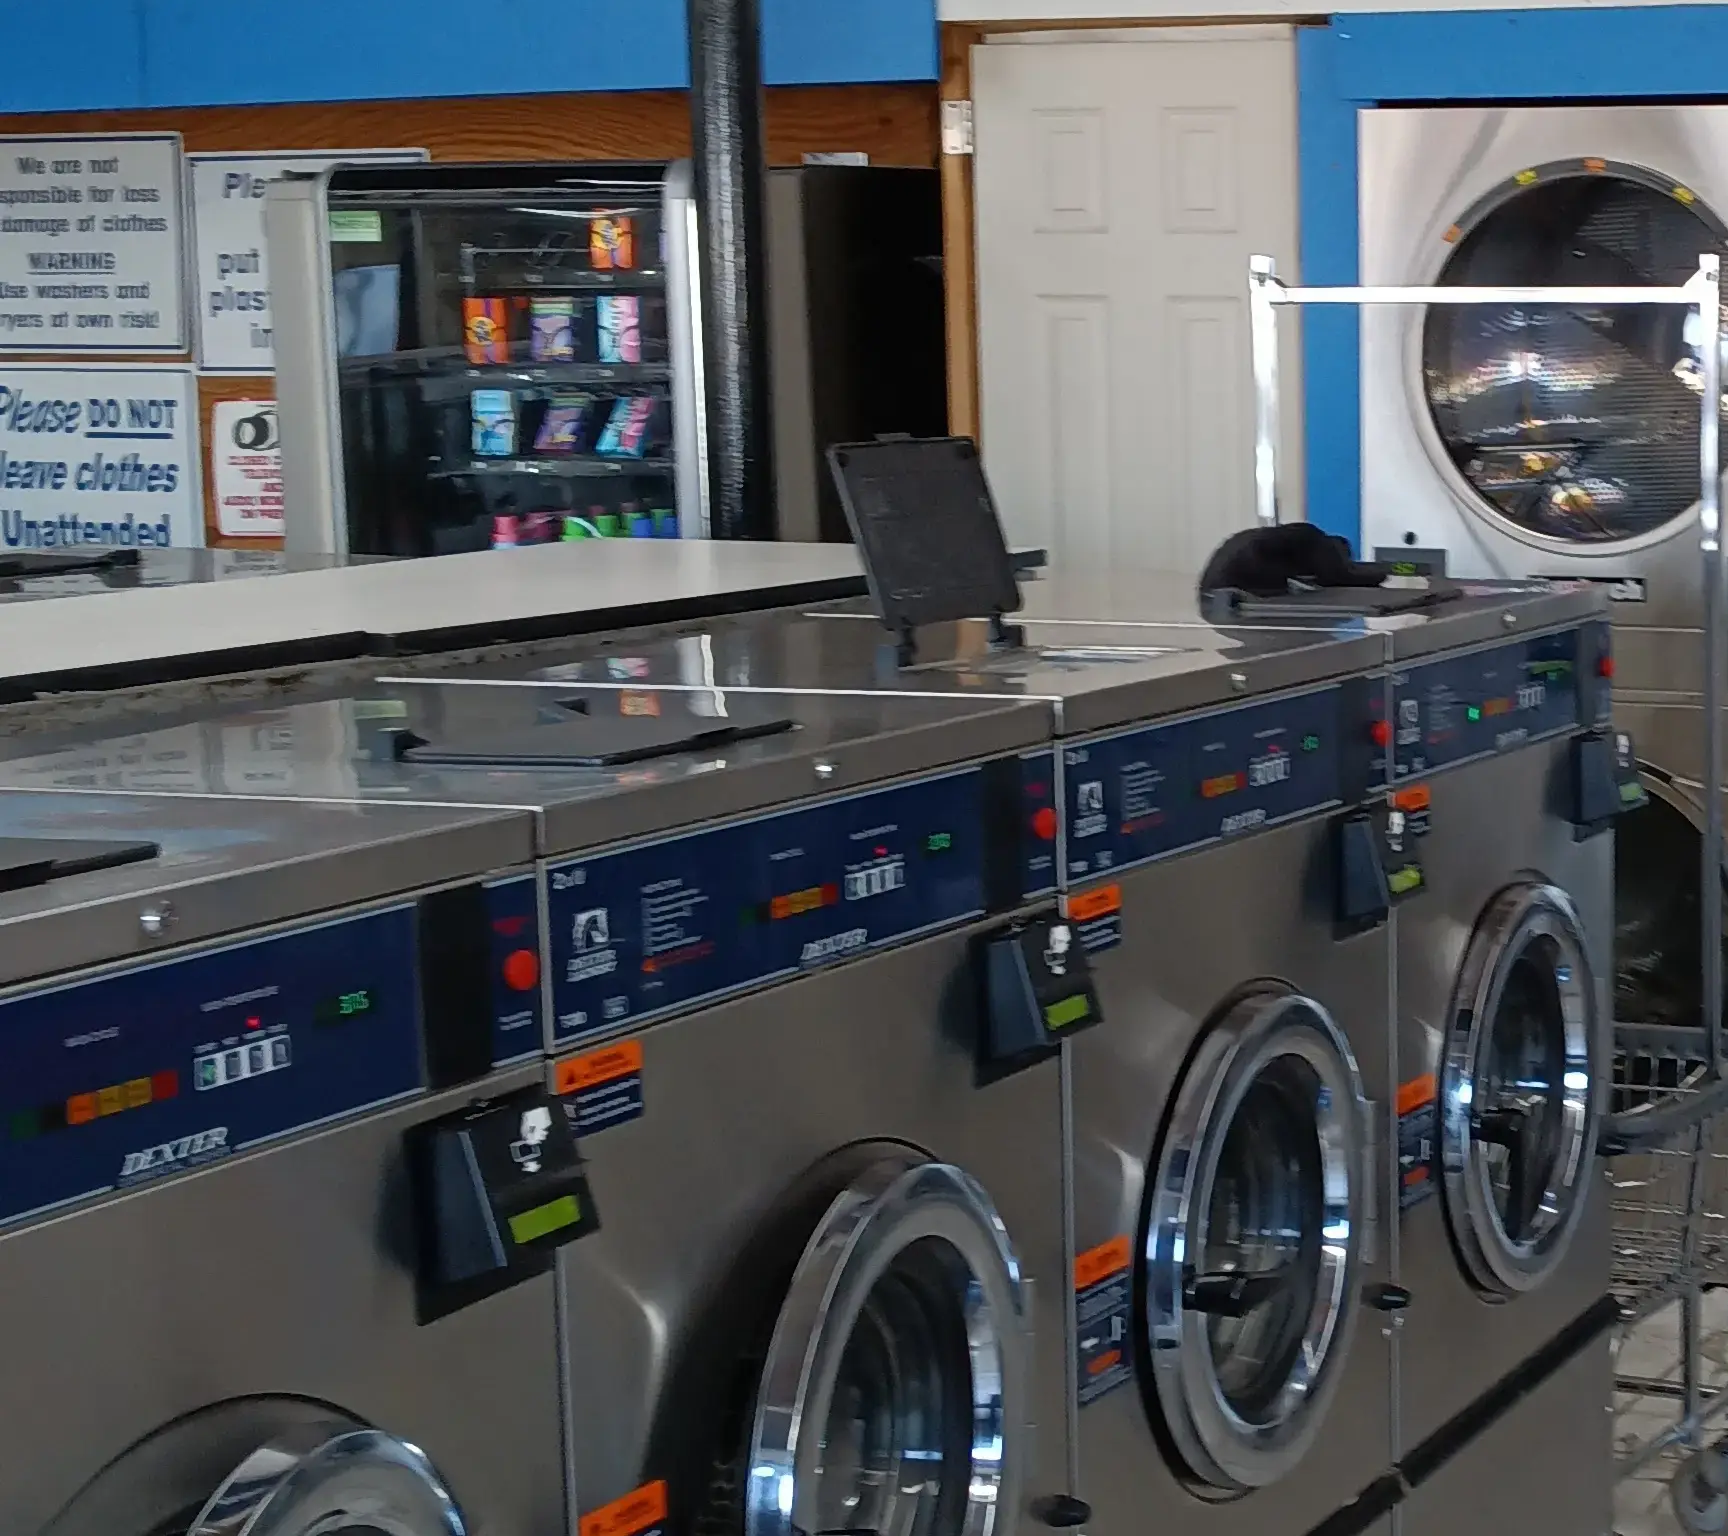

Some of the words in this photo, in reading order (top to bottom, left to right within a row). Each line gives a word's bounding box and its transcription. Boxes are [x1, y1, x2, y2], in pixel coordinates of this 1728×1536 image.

[15, 156, 46, 175] We
[51, 158, 82, 174] are
[88, 156, 120, 174] not
[88, 186, 115, 203] for
[121, 185, 161, 203] loss
[76, 214, 96, 233] of
[102, 214, 168, 233] clothes
[27, 251, 117, 271] WARNING
[35, 283, 109, 300] washers
[115, 281, 150, 300] and
[76, 314, 113, 329] own
[85, 397, 122, 428] DO
[126, 398, 179, 429] NOT
[74, 451, 180, 493] clothes
[1, 509, 172, 548] Unattended
[118, 1125, 229, 1176] DEXTER
